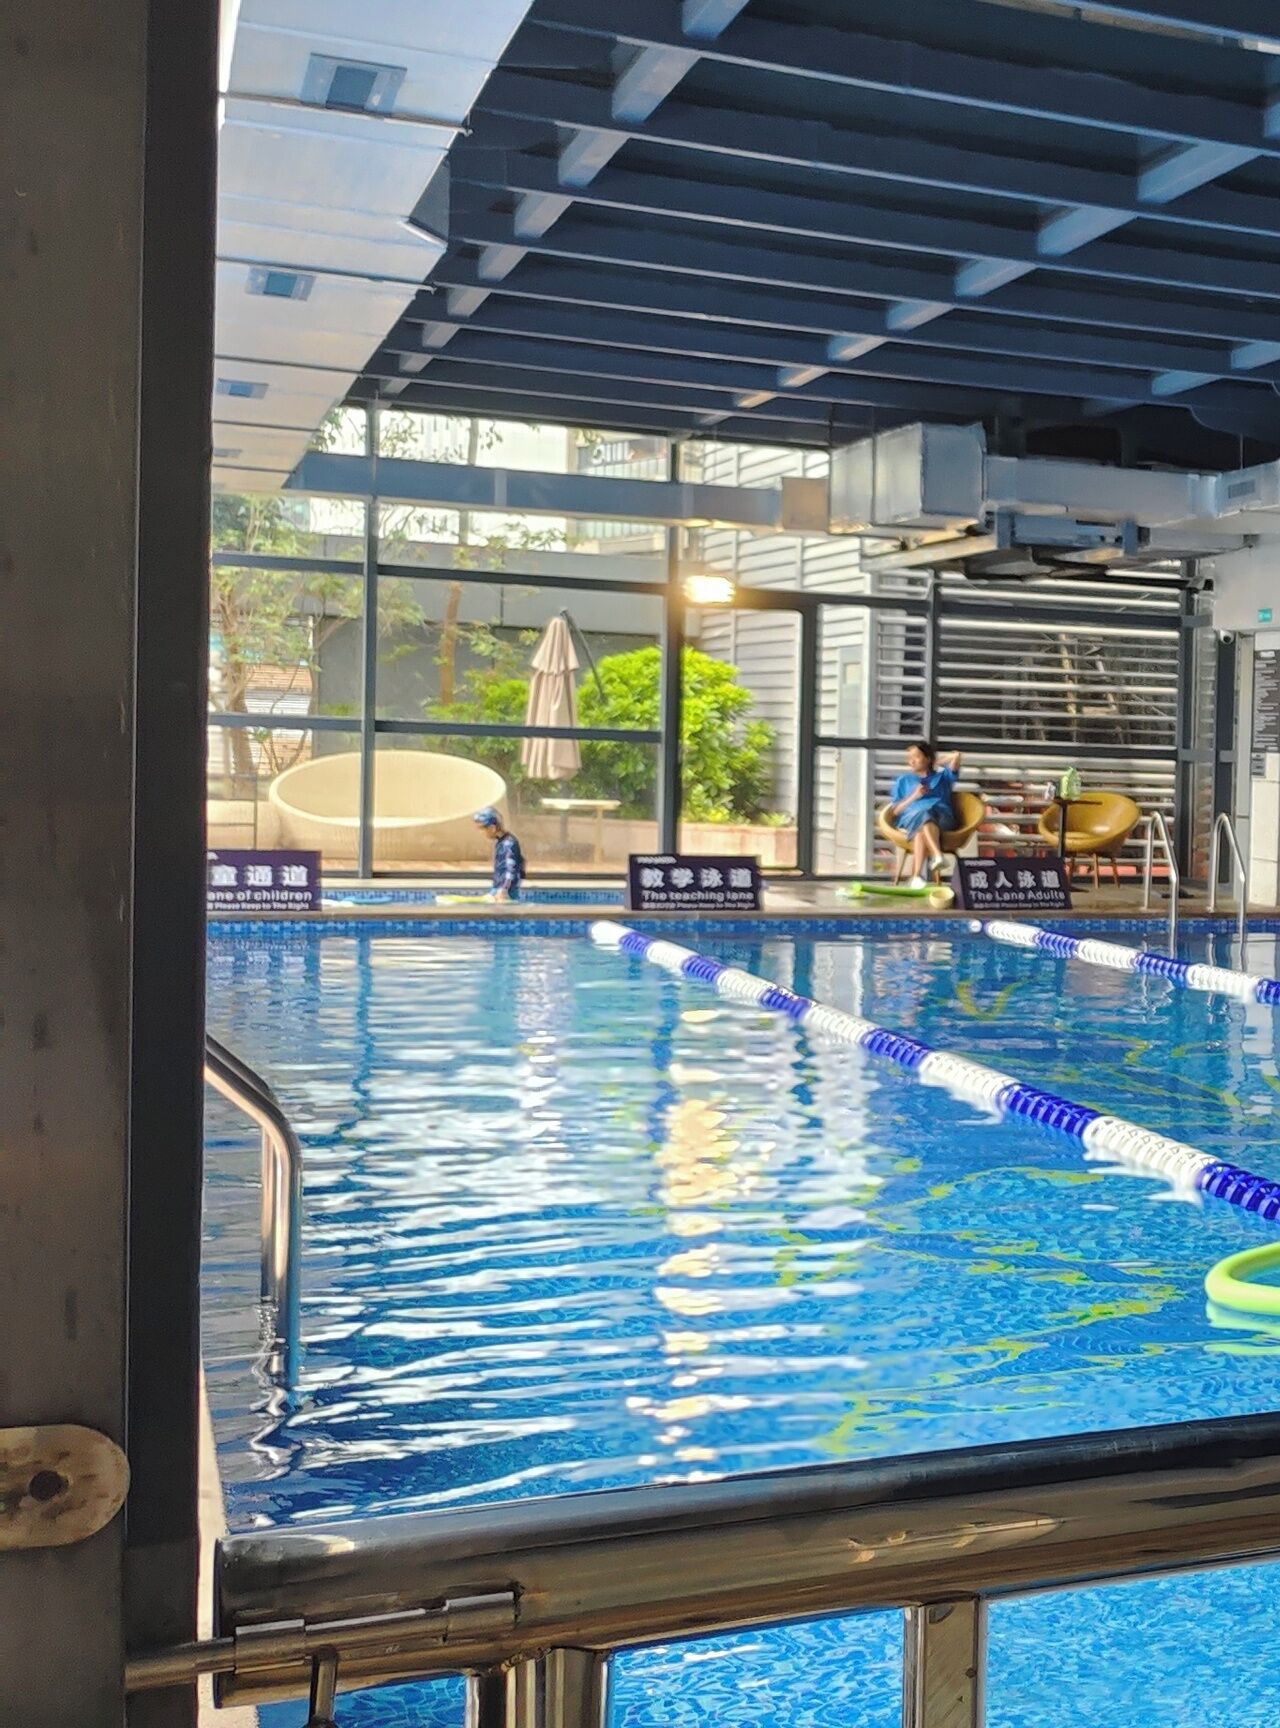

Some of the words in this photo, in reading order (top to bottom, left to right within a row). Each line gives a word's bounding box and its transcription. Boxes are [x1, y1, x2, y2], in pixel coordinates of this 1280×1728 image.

[211, 864, 309, 887] 童通道
[640, 866, 753, 889] 教学泳道
[969, 869, 1061, 889] 成人泳道
[237, 890, 251, 902] of
[254, 890, 313, 902] children
[642, 889, 667, 901] The
[669, 890, 725, 902] teaching
[970, 890, 993, 901] The
[995, 890, 1026, 901] Lane
